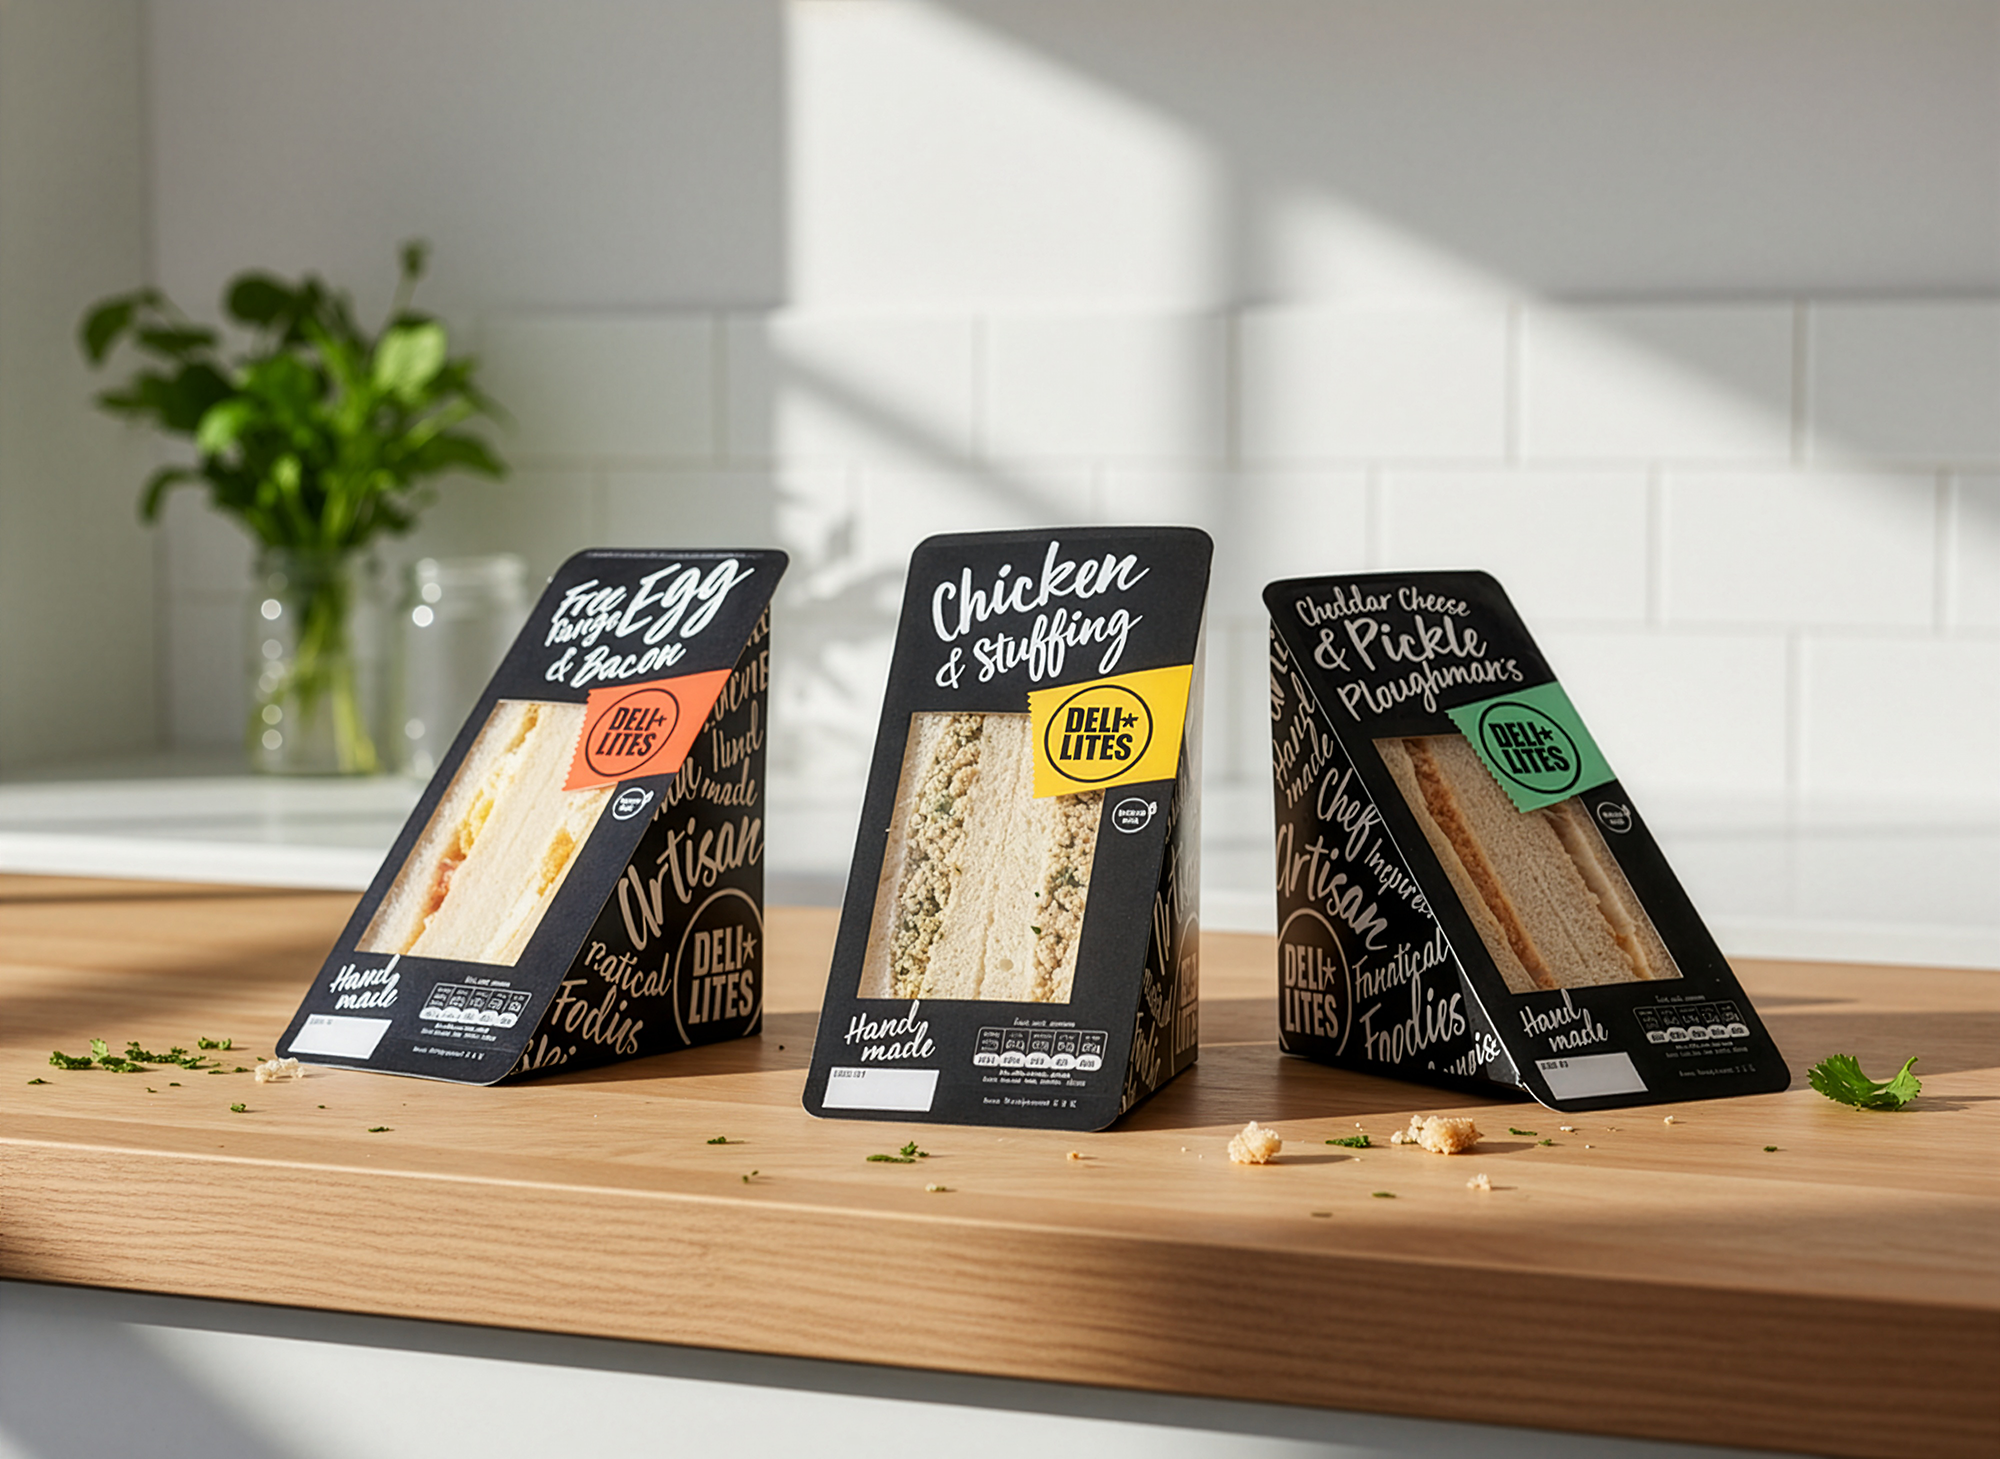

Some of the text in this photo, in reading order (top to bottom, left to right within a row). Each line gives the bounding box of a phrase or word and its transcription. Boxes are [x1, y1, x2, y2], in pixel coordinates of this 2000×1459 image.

[551, 579, 628, 623] Free
[615, 559, 755, 645] Egg
[932, 541, 1150, 642] Chicken
[1295, 584, 1471, 627] Cheddar Cheese
[935, 607, 1143, 689] & Stuffing
[1313, 614, 1487, 672] & Pickle
[545, 646, 578, 682] &
[570, 645, 687, 688] Bacon
[1337, 658, 1524, 722] Ploughman's
[608, 706, 661, 732] DELI
[1064, 707, 1123, 733] DELI
[1488, 722, 1544, 748] DELI
[595, 732, 657, 757] LITES
[1059, 733, 1134, 761] LITES
[1501, 746, 1570, 775] LITES
[618, 816, 764, 951] Artisan
[692, 925, 744, 977] DELI
[1284, 943, 1325, 991] DELI
[329, 953, 401, 994] Hand
[335, 974, 399, 1011] made
[688, 968, 754, 1024] LITES
[1285, 988, 1339, 1039] LITES
[1519, 988, 1582, 1038] Hand
[844, 1000, 923, 1045] Hand
[860, 1021, 936, 1062] made
[1548, 1008, 1609, 1052] made
